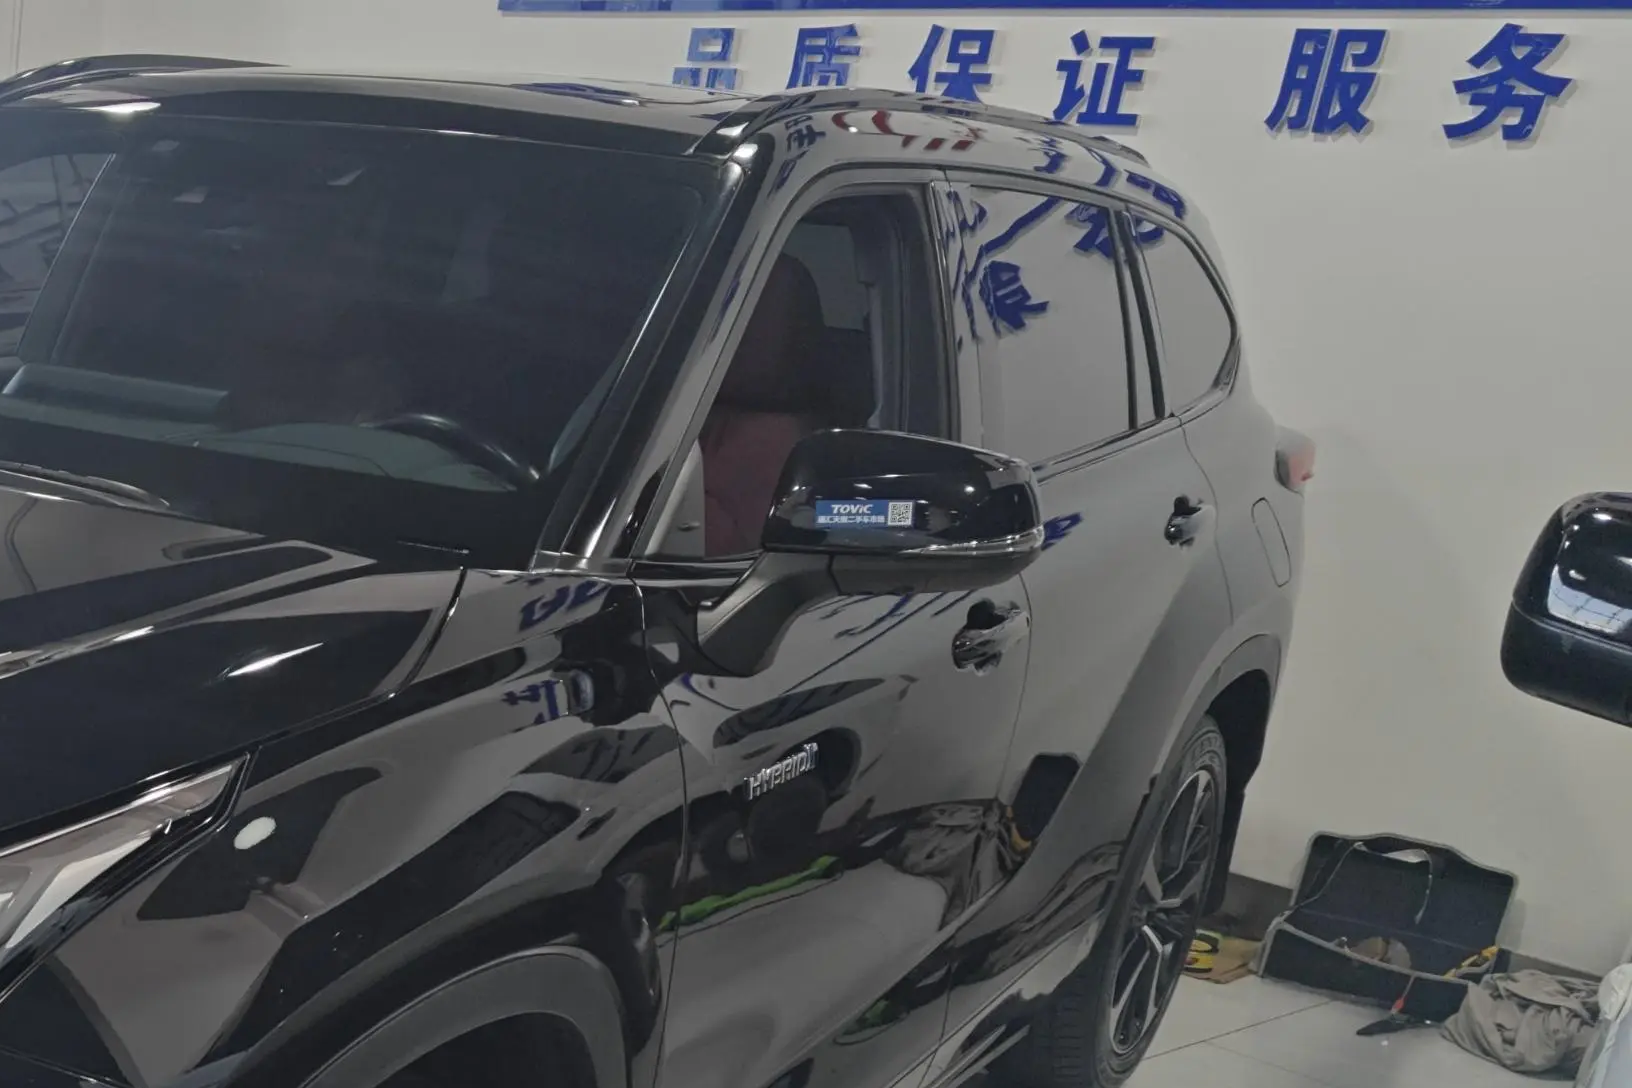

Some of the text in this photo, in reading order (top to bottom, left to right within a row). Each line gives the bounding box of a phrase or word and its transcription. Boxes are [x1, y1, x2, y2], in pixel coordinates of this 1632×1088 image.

[672, 22, 1573, 141] 品质保证 服务
